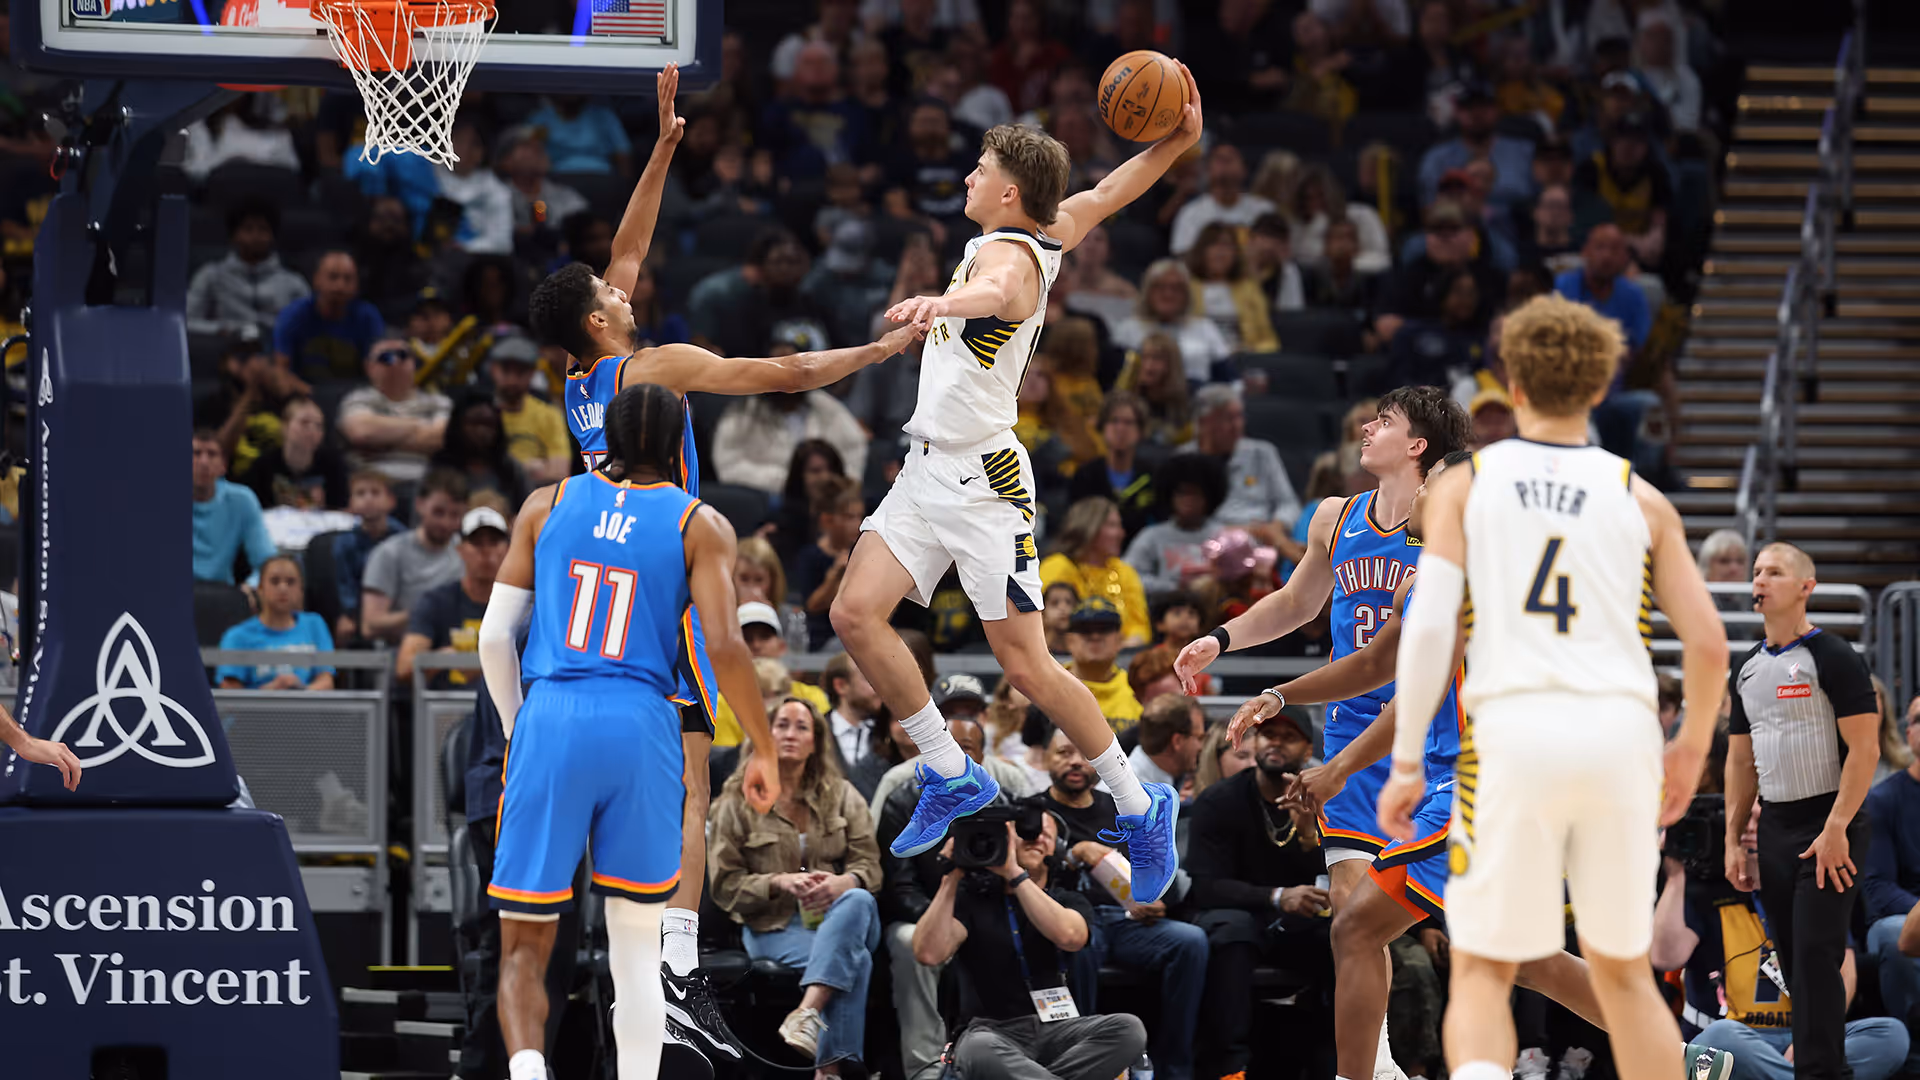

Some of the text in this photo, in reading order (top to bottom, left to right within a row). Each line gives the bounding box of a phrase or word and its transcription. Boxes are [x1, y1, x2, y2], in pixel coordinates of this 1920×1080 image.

[77, 0, 97, 11] NBA
[1101, 66, 1132, 118] Wilson
[41, 419, 51, 591] Ascension
[1514, 479, 1587, 517] PETER
[592, 510, 637, 544] JOE
[565, 558, 638, 661] 11
[1523, 533, 1577, 635] 4
[0, 952, 311, 1005] t. Vincent
